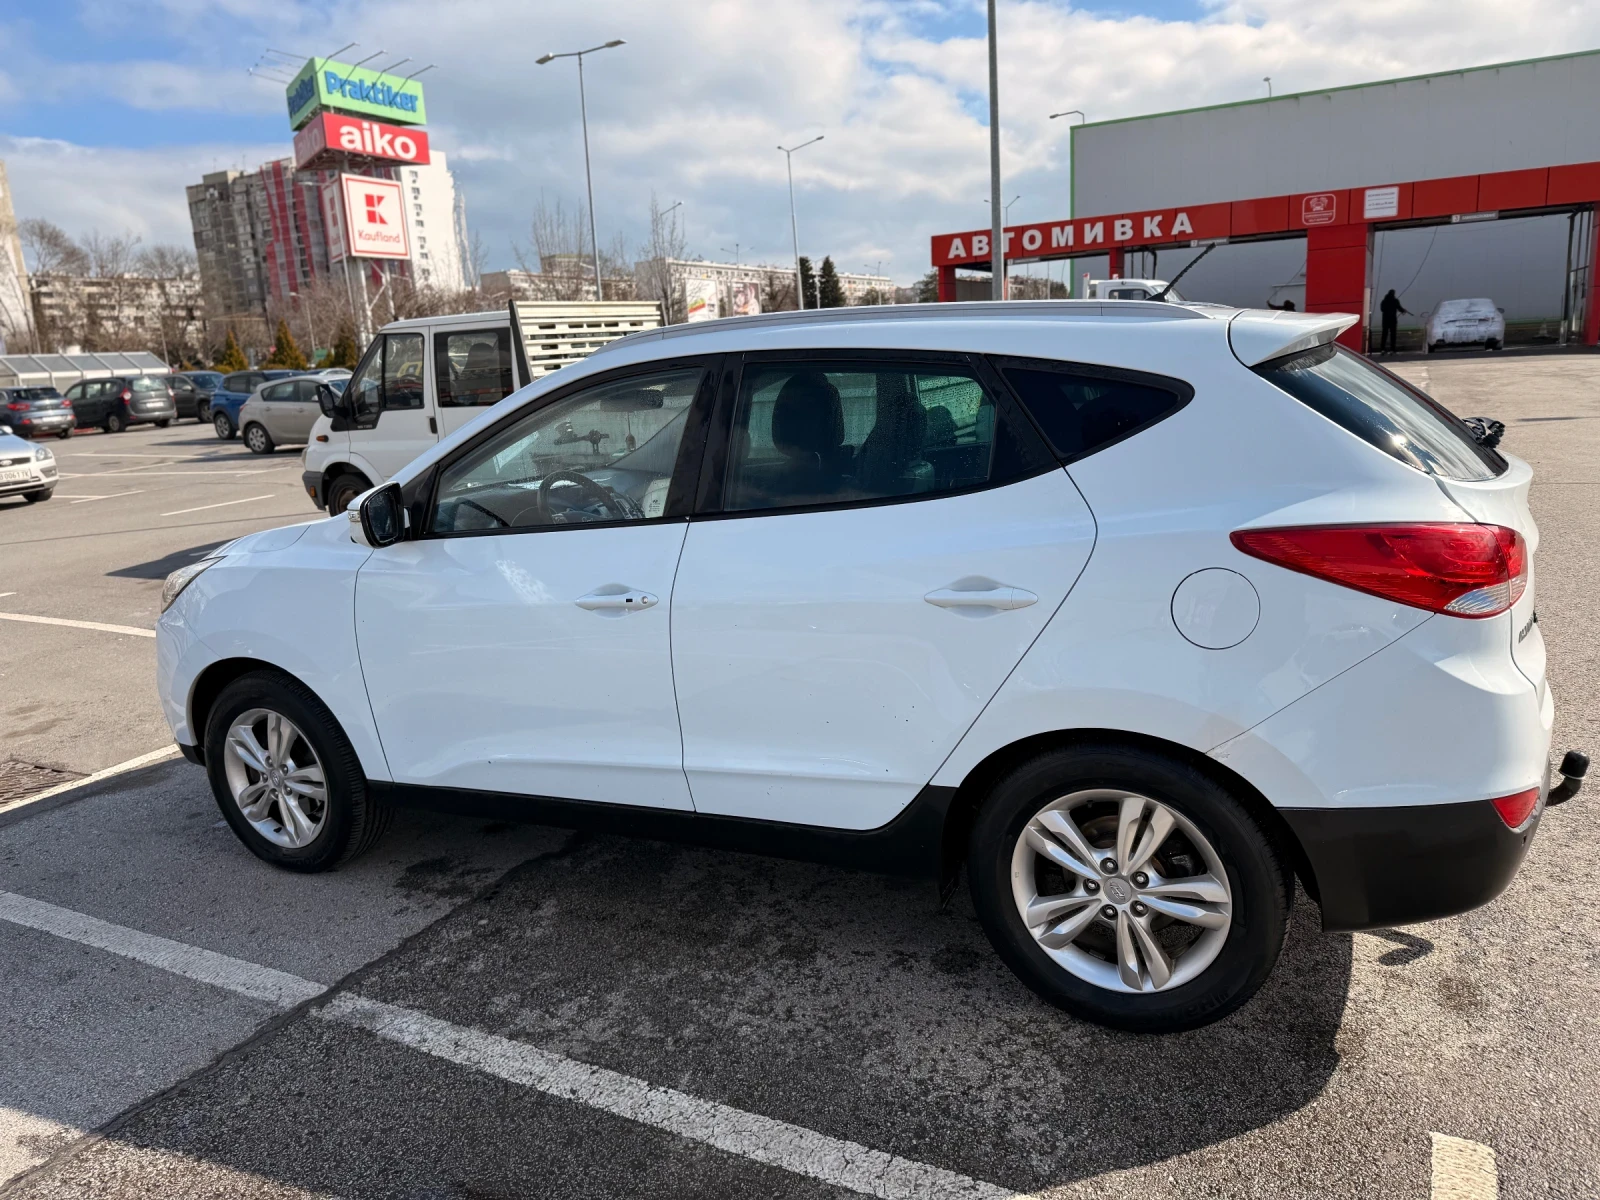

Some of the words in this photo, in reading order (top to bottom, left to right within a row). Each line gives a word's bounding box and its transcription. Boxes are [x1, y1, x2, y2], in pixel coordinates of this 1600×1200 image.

[324, 70, 418, 112] Praktiker
[340, 122, 417, 160] aiko
[358, 229, 400, 244] Kaufland
[948, 212, 1193, 259] АВТОМИВКА
